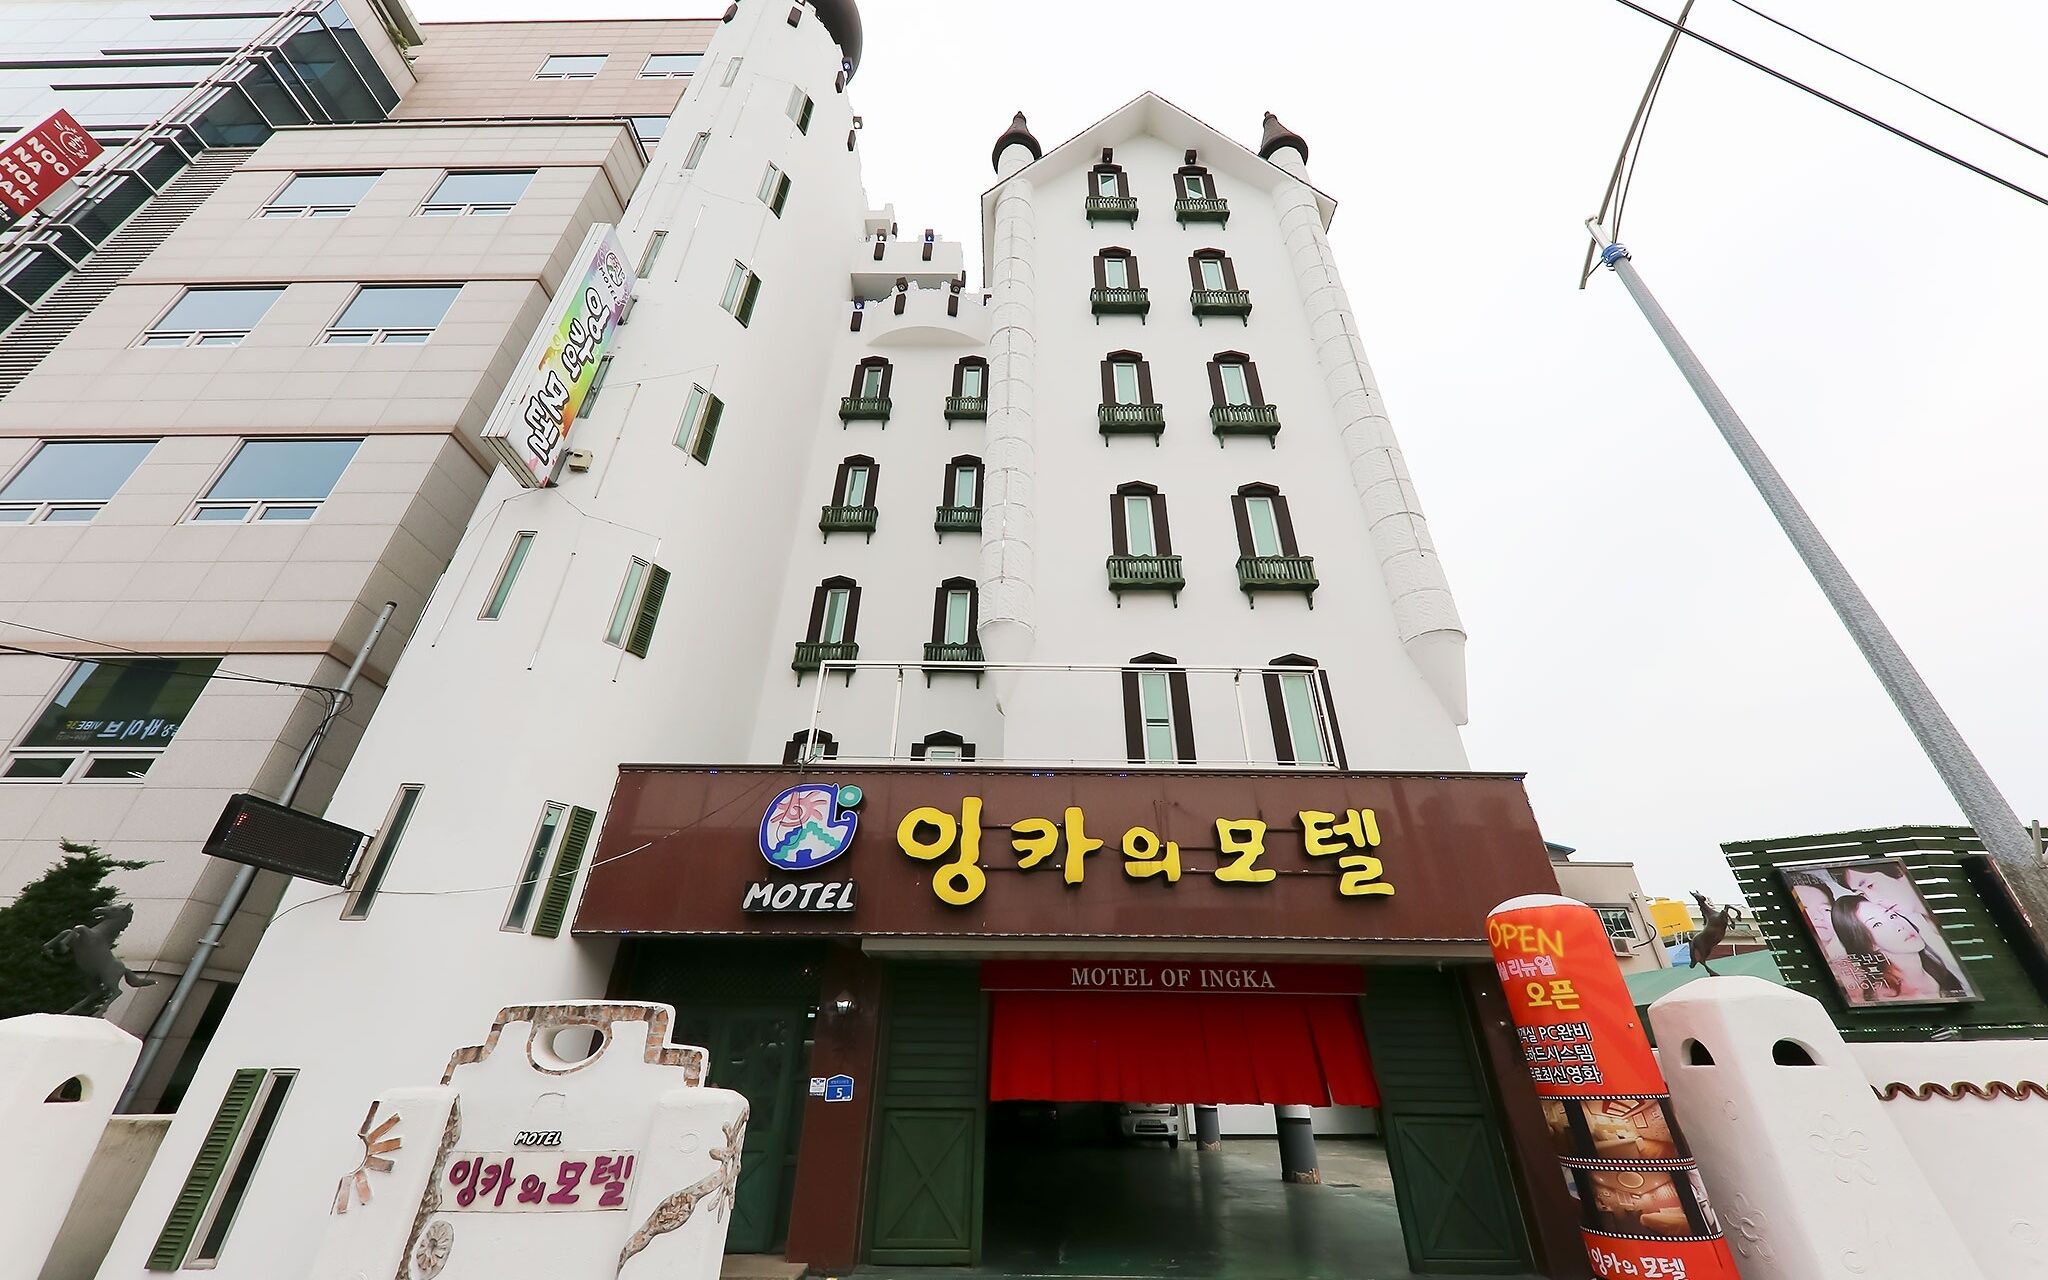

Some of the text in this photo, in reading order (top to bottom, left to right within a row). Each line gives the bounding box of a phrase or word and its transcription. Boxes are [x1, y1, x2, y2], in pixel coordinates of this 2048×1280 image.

[13, 147, 42, 175] NA
[26, 136, 69, 176] NOO
[0, 156, 39, 195] HOL
[0, 172, 31, 207] AK
[598, 267, 619, 302] MOTEL
[742, 882, 855, 910] MOTEL
[1489, 918, 1564, 958] OPEN
[1071, 967, 1276, 989] MOTEL OF INGKA
[1526, 979, 1581, 1010] 오픈
[1538, 1022, 1592, 1041] PC완비
[836, 1087, 843, 1098] 5
[514, 1130, 564, 1146] MOTEL
[1591, 1247, 1688, 1280] 잉카의 모텔
